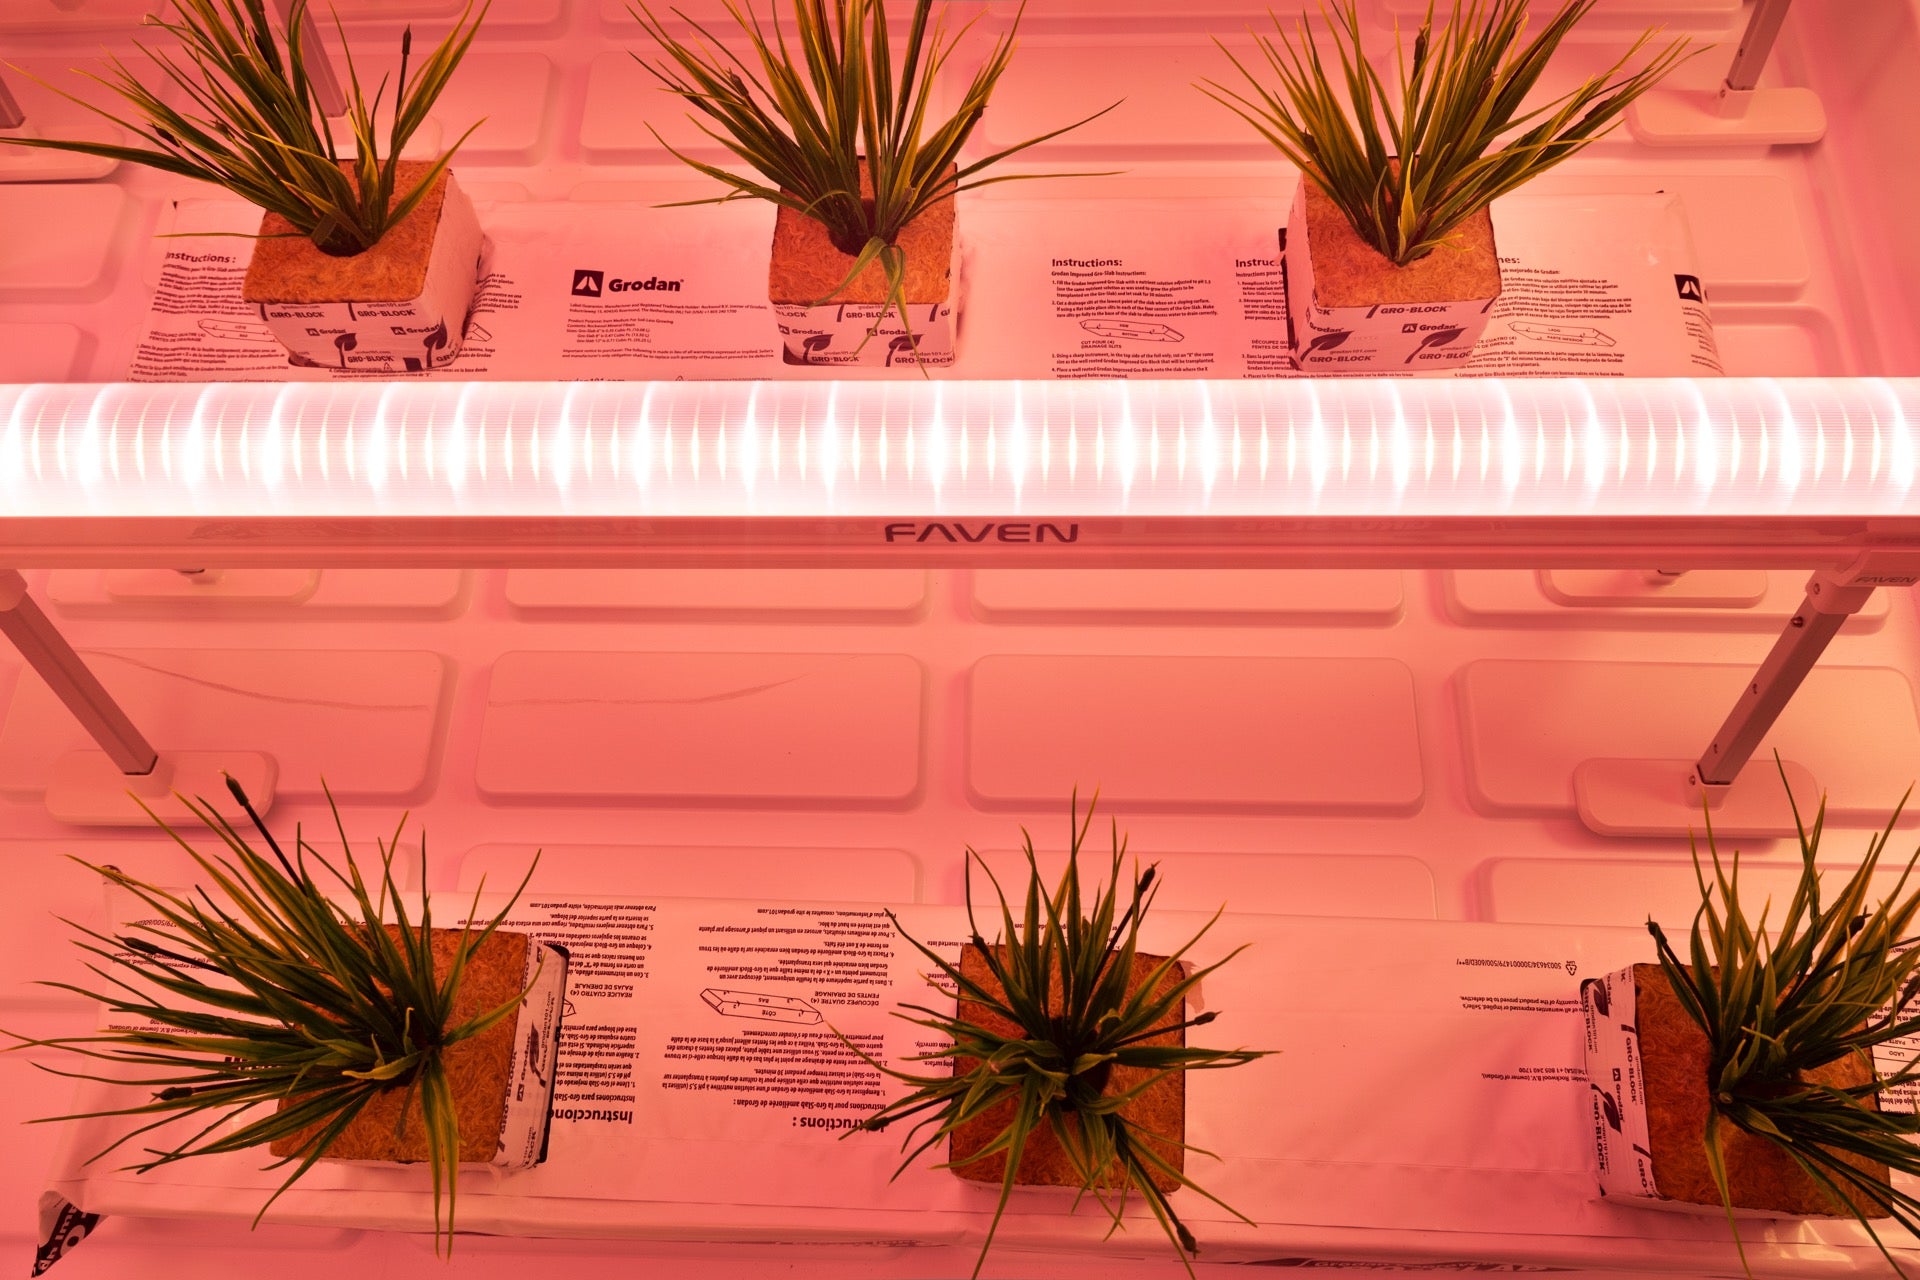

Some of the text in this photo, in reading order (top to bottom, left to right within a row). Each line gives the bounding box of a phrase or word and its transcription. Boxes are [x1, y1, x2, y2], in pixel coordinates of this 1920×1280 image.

[1052, 259, 1122, 267] Instructions:
[885, 523, 1078, 542] FAVEN
[554, 1093, 580, 1101] Gro-Slab
[596, 1094, 635, 1102] Instrucciones
[736, 1099, 759, 1107] Grodan
[769, 1100, 800, 1108] améliorée
[800, 1101, 827, 1109] Gro-Slab
[850, 1103, 886, 1112] Instructions
[800, 1117, 884, 1133] tructions
